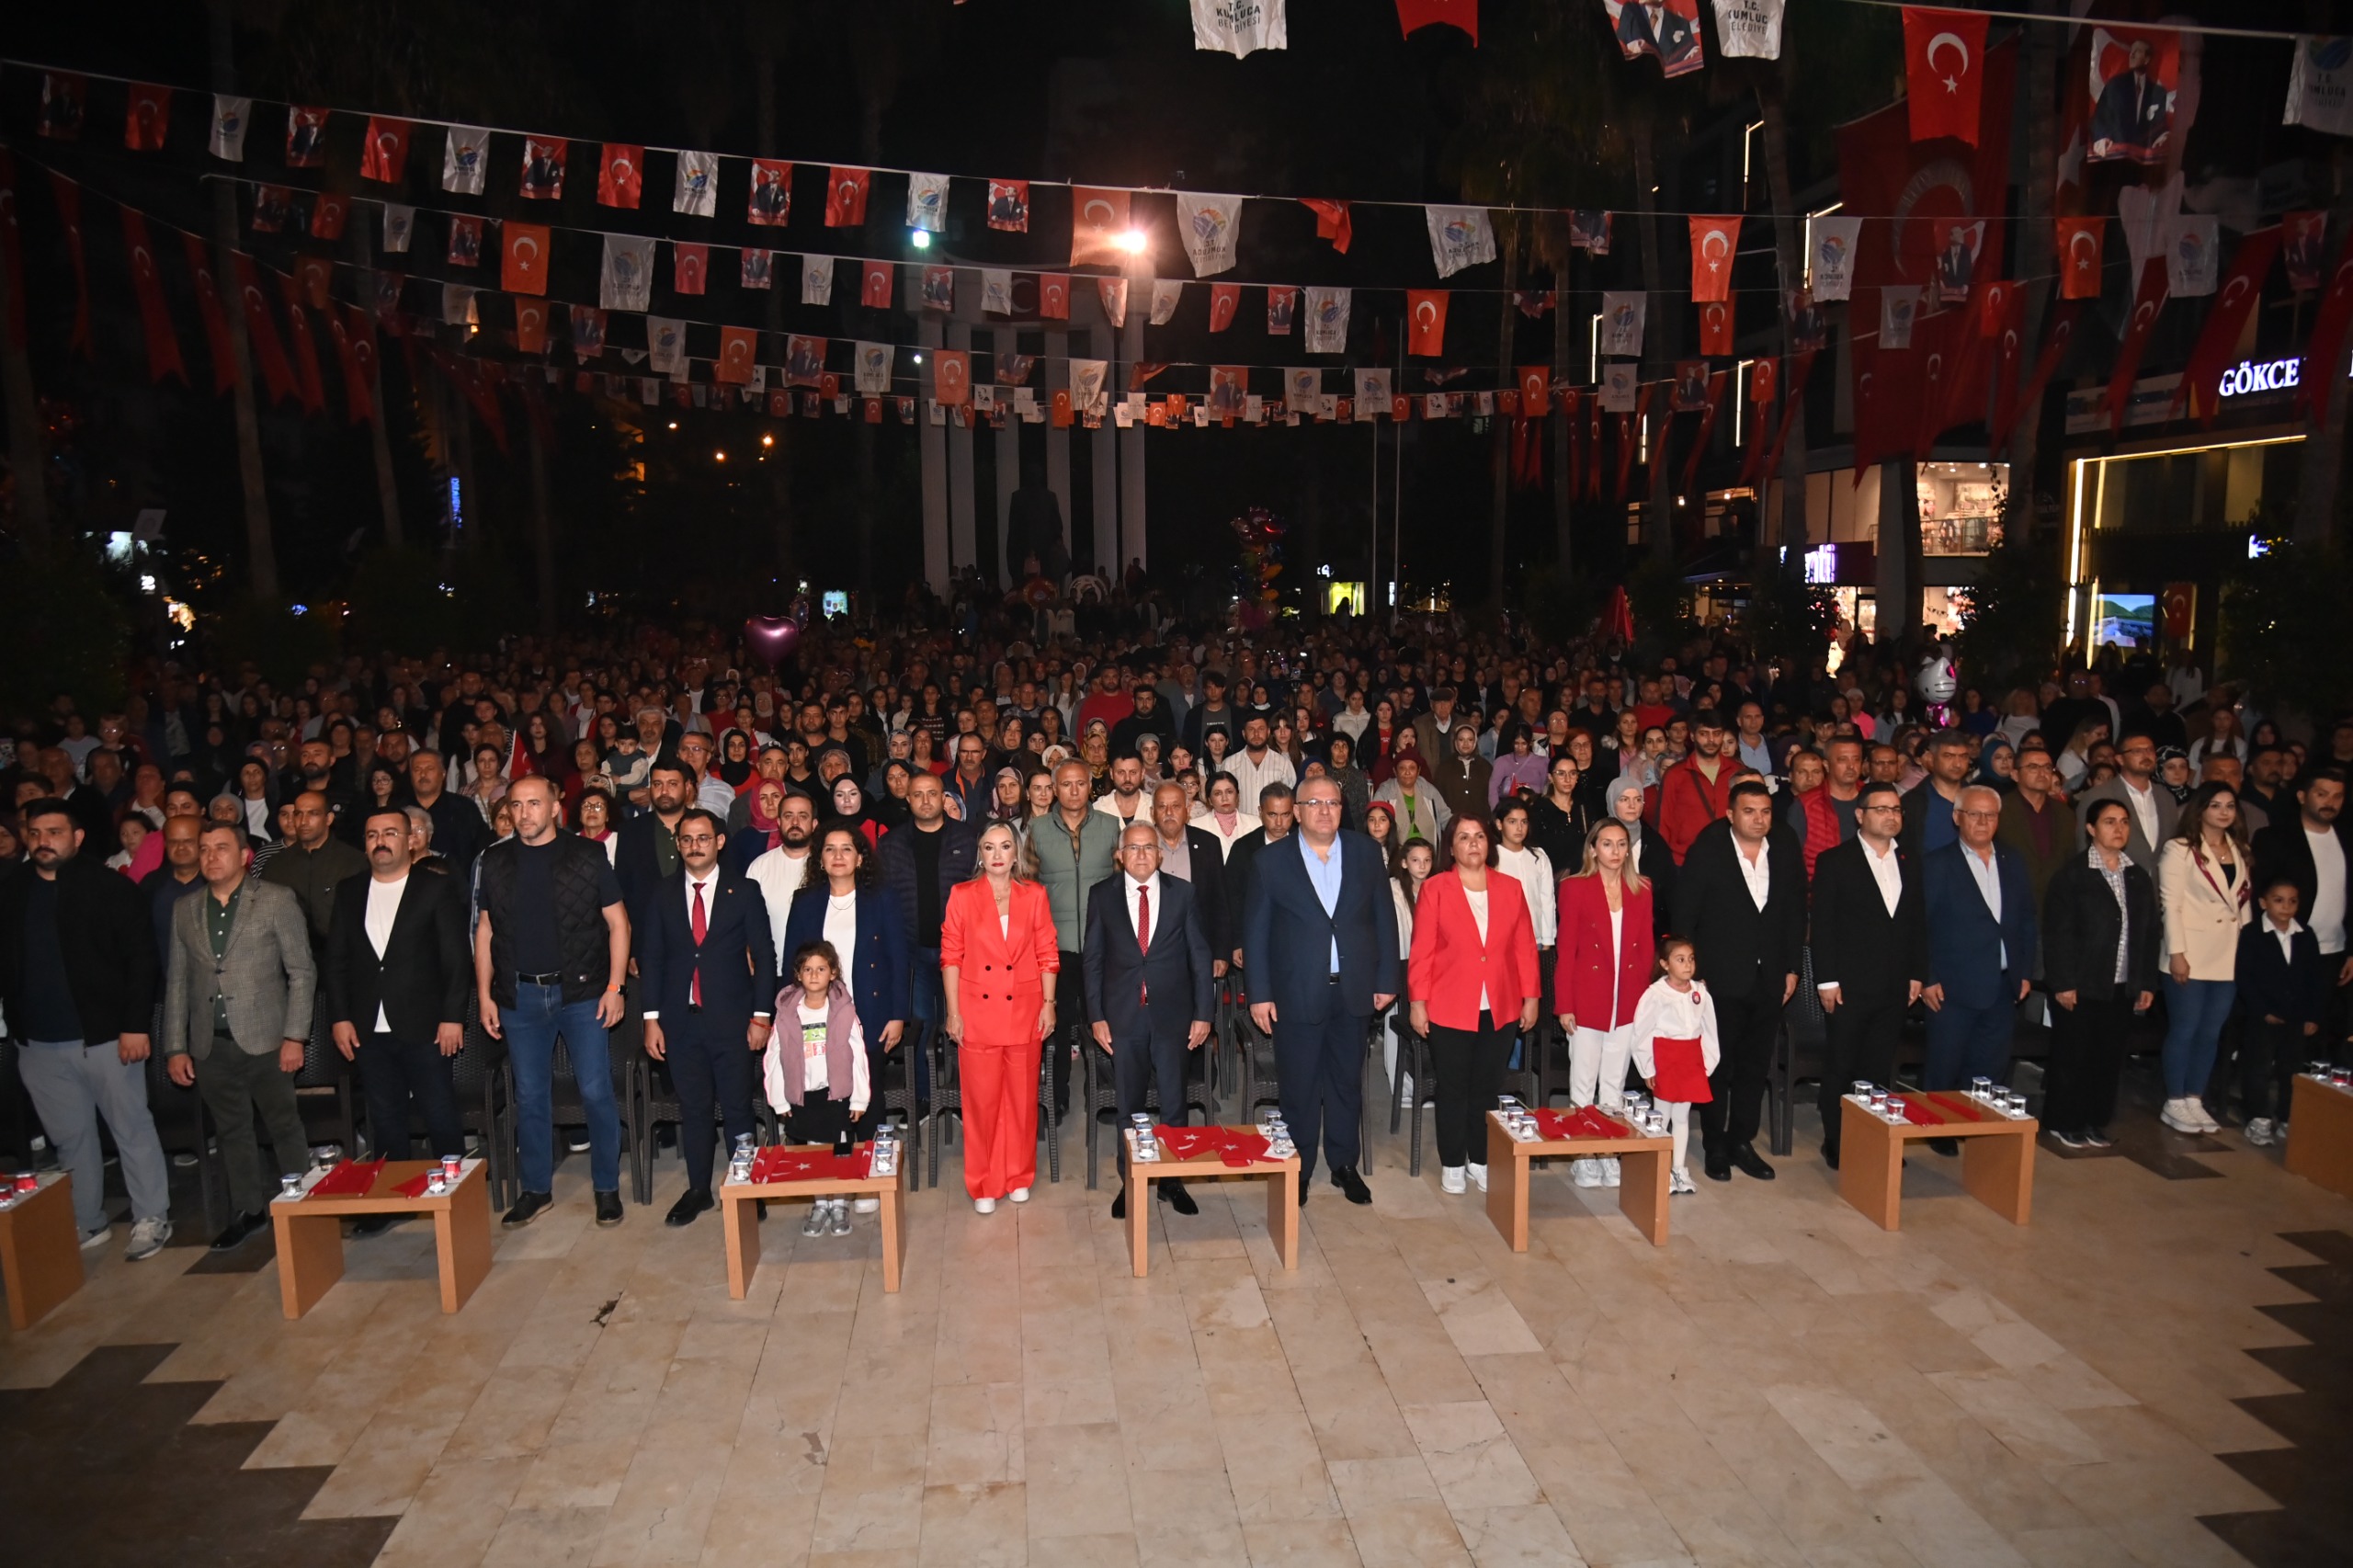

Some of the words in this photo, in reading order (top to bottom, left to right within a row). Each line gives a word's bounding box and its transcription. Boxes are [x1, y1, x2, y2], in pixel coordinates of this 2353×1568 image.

[1228, 1, 1244, 12] T.C.
[1745, 1, 1759, 11] T.C.
[1728, 9, 1768, 24] KUMLUC
[2308, 85, 2345, 97] UMLUCA
